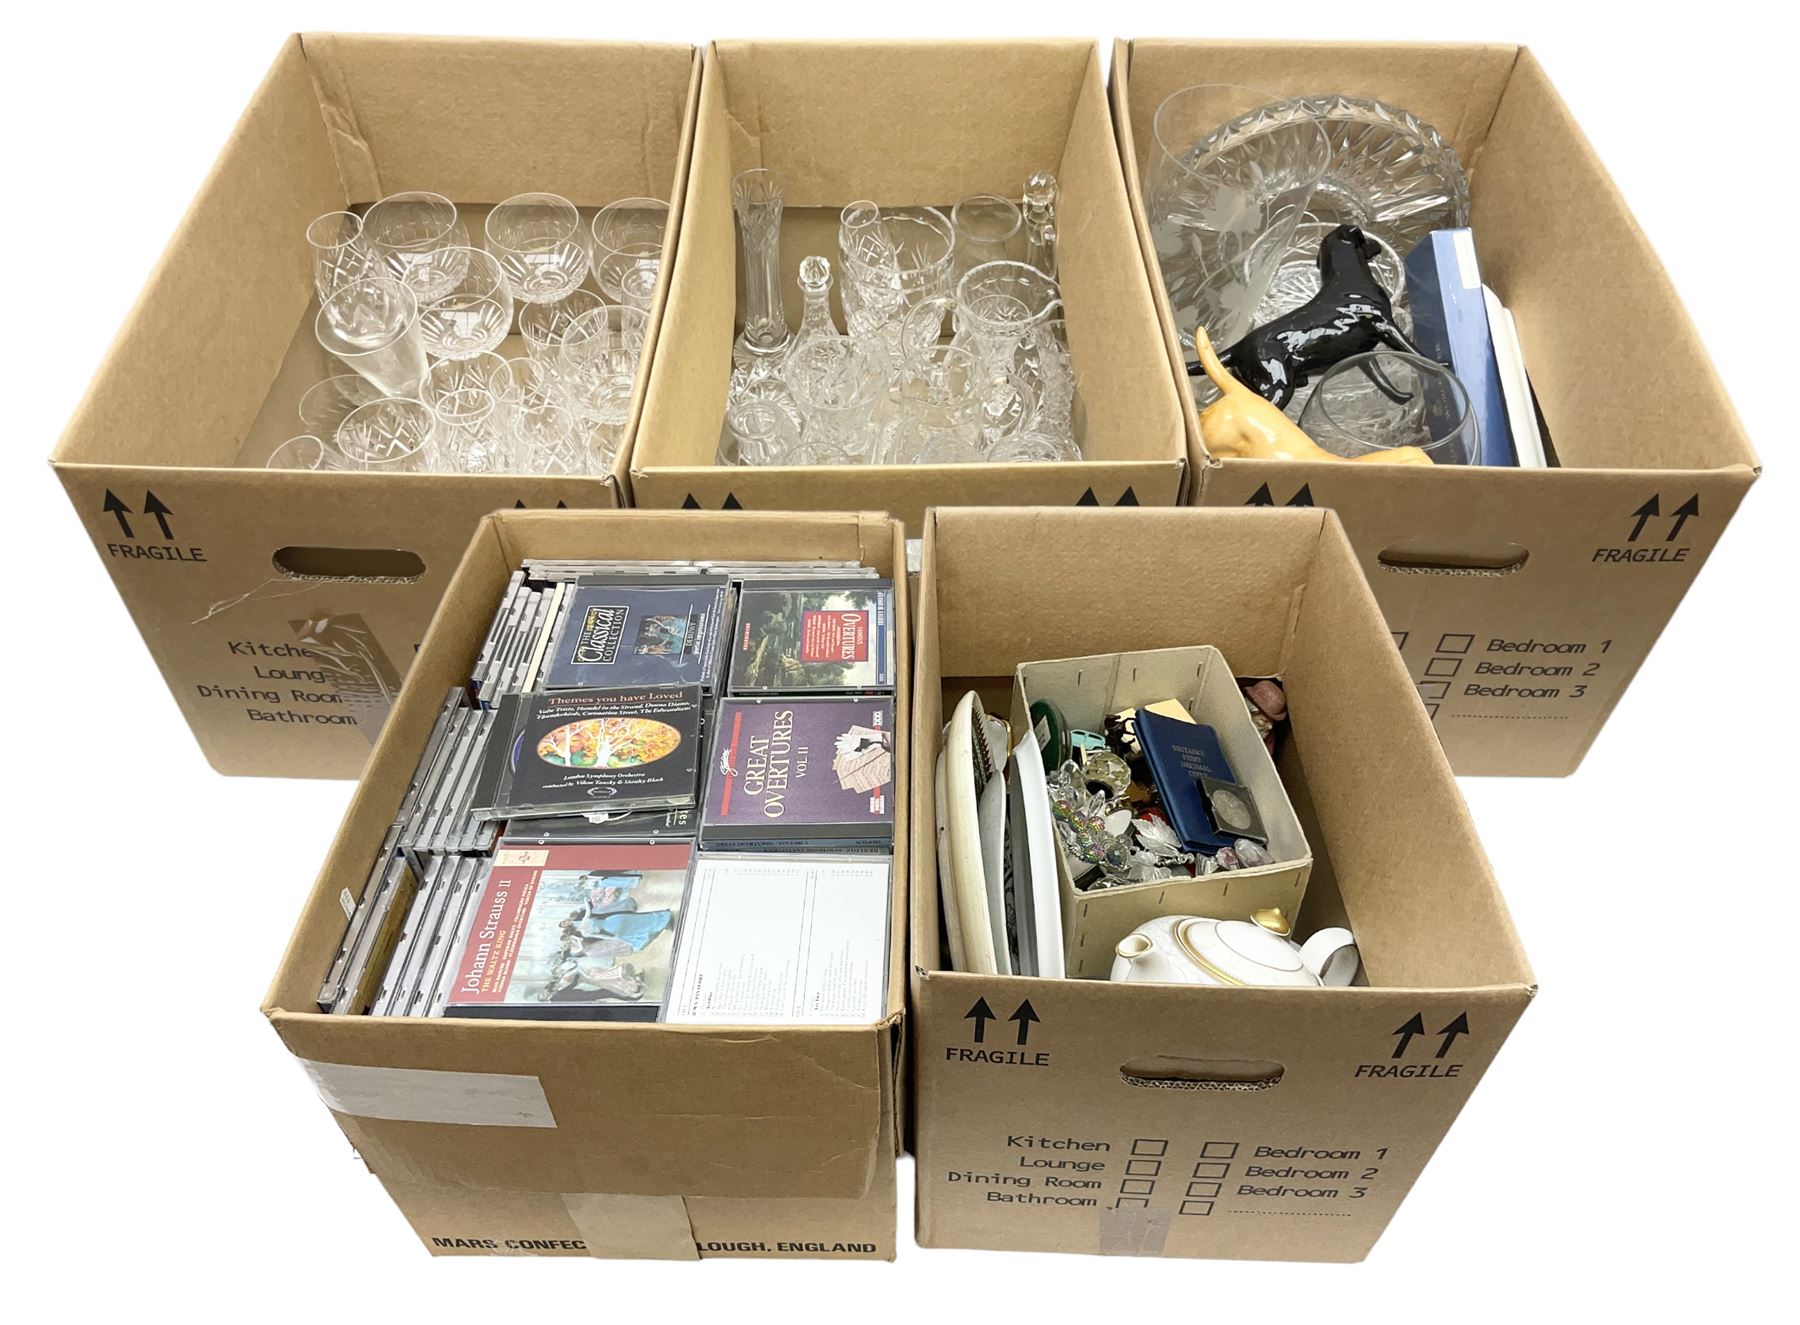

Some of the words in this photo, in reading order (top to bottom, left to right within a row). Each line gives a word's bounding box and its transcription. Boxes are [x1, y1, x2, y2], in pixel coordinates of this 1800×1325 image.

[107, 543, 207, 562] FRAGILE
[1591, 548, 1691, 563] FRAGILE
[578, 608, 615, 662] Classical
[581, 632, 592, 645] THE
[603, 609, 625, 662] COLLECTION
[841, 613, 862, 660] OVERTURES
[228, 641, 314, 658] Kitche
[1487, 638, 1587, 654] Bedroom
[1600, 640, 1613, 654] 1
[253, 665, 326, 683] Loung
[1475, 661, 1573, 677] Bedroom
[1582, 662, 1601, 677] 2
[197, 684, 281, 704] Dining
[549, 697, 594, 705] Themes
[620, 694, 646, 702] have
[648, 691, 683, 700] Loved
[1463, 684, 1561, 699] Bedroom
[1568, 684, 1589, 698] 3
[246, 708, 358, 725] Bathroom
[744, 735, 771, 795] GREAT
[764, 710, 795, 819] OVERTURES
[461, 943, 491, 995] Johann
[479, 890, 508, 939] Strauss
[499, 880, 512, 888] II
[495, 930, 507, 949] KING
[486, 950, 500, 976] WALTZ
[482, 977, 492, 993] THE
[946, 1047, 1050, 1066] FRAGILE
[1354, 1064, 1464, 1078] FRAGILE
[1007, 1135, 1111, 1152] Kitchen
[1254, 1146, 1360, 1160] Bedroom
[1375, 1148, 1388, 1160] 1
[1020, 1156, 1105, 1172] Lounge
[948, 1171, 1031, 1188] Dining
[1045, 1176, 1102, 1189] Room
[1245, 1166, 1349, 1180] Bedroom
[1360, 1167, 1379, 1180] 2
[987, 1191, 1097, 1206] Bathroom
[1237, 1185, 1338, 1198] Bedroom
[1349, 1187, 1368, 1198] 3
[431, 1237, 498, 1249] MARS
[504, 1239, 587, 1250] CONFEC
[776, 1242, 877, 1253] ENGLAND
